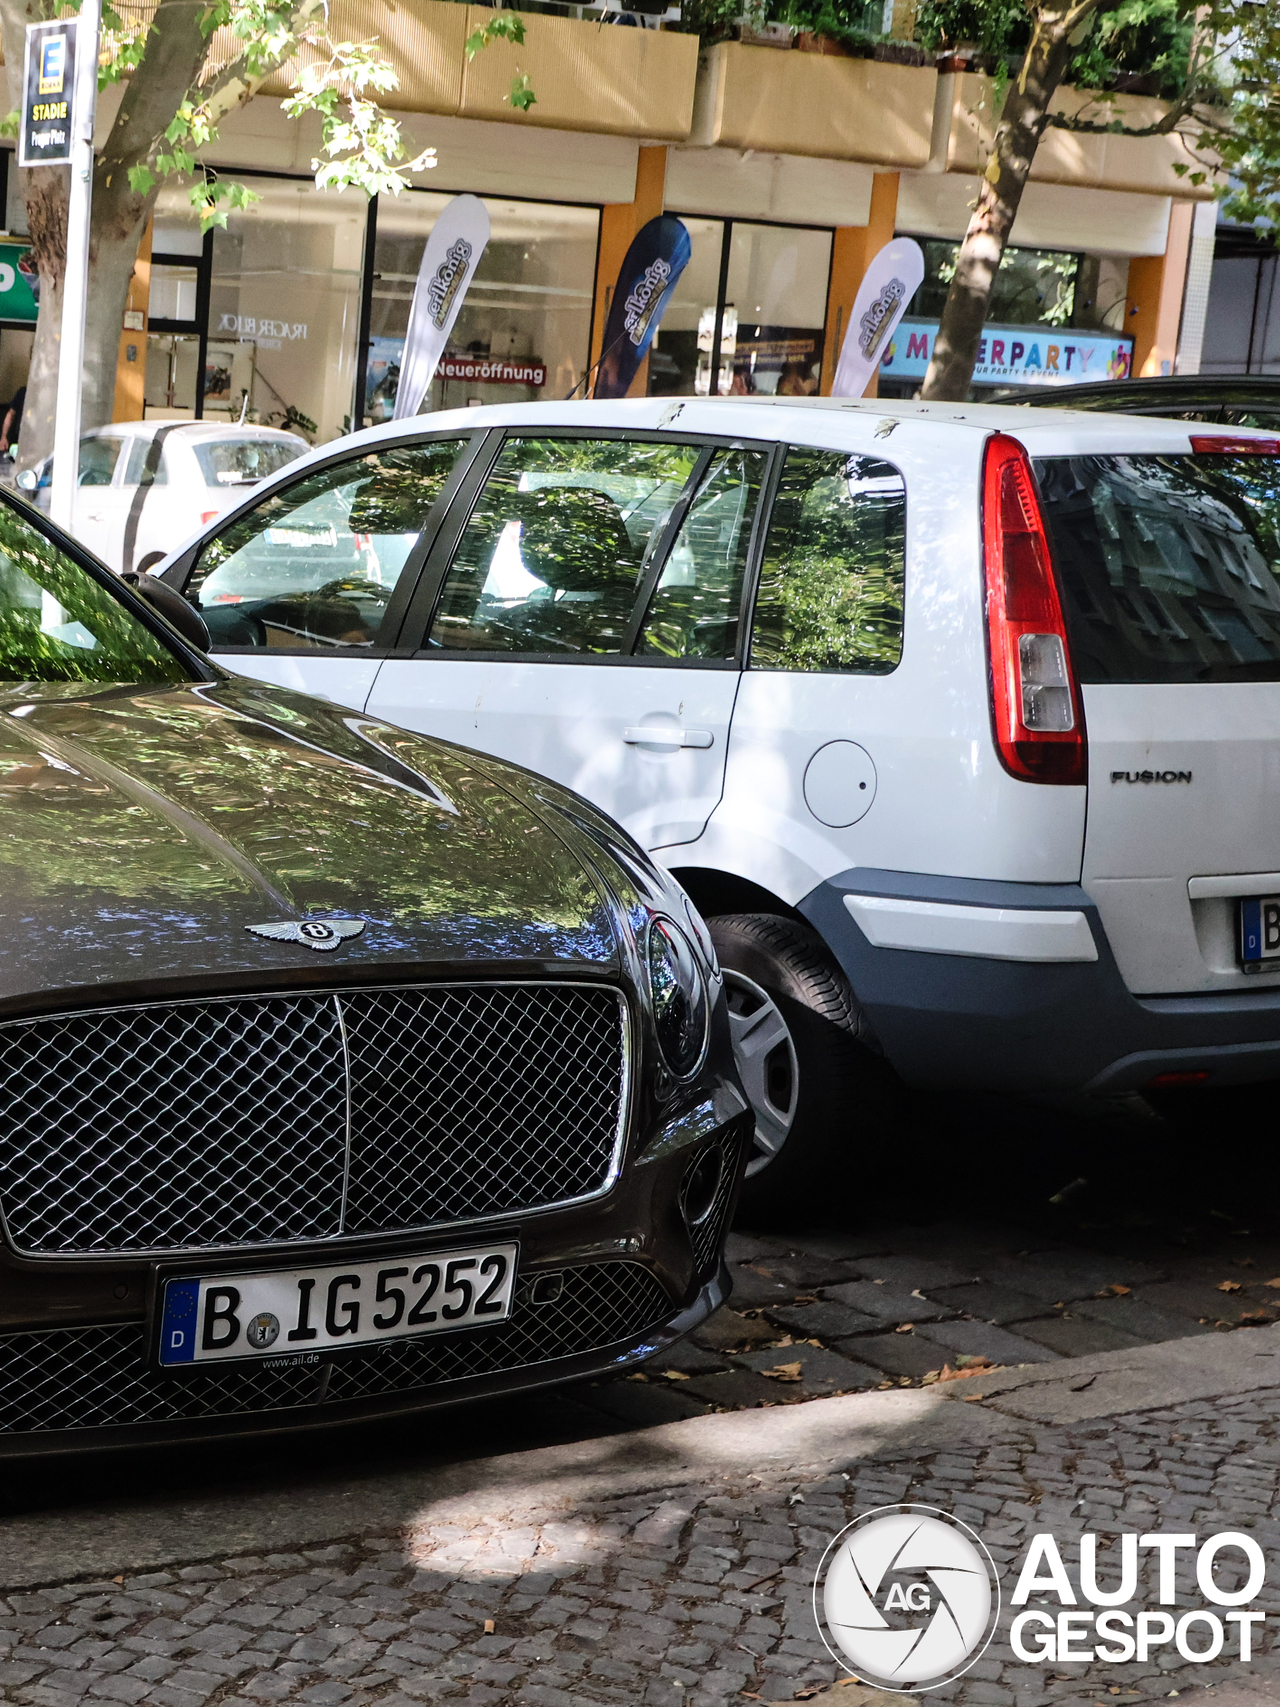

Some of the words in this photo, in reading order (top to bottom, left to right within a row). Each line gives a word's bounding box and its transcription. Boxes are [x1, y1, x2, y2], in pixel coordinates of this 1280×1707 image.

[33, 102, 67, 121] STADIE
[31, 131, 51, 149] Prager
[51, 129, 66, 144] Platz
[435, 361, 544, 384] Neueröffnung
[991, 367, 1019, 375] PARTY
[1110, 770, 1192, 784] FUSION
[1264, 903, 1280, 950] B
[201, 1286, 241, 1350] B
[171, 1330, 184, 1348] D
[262, 1353, 320, 1369] www.ail.de
